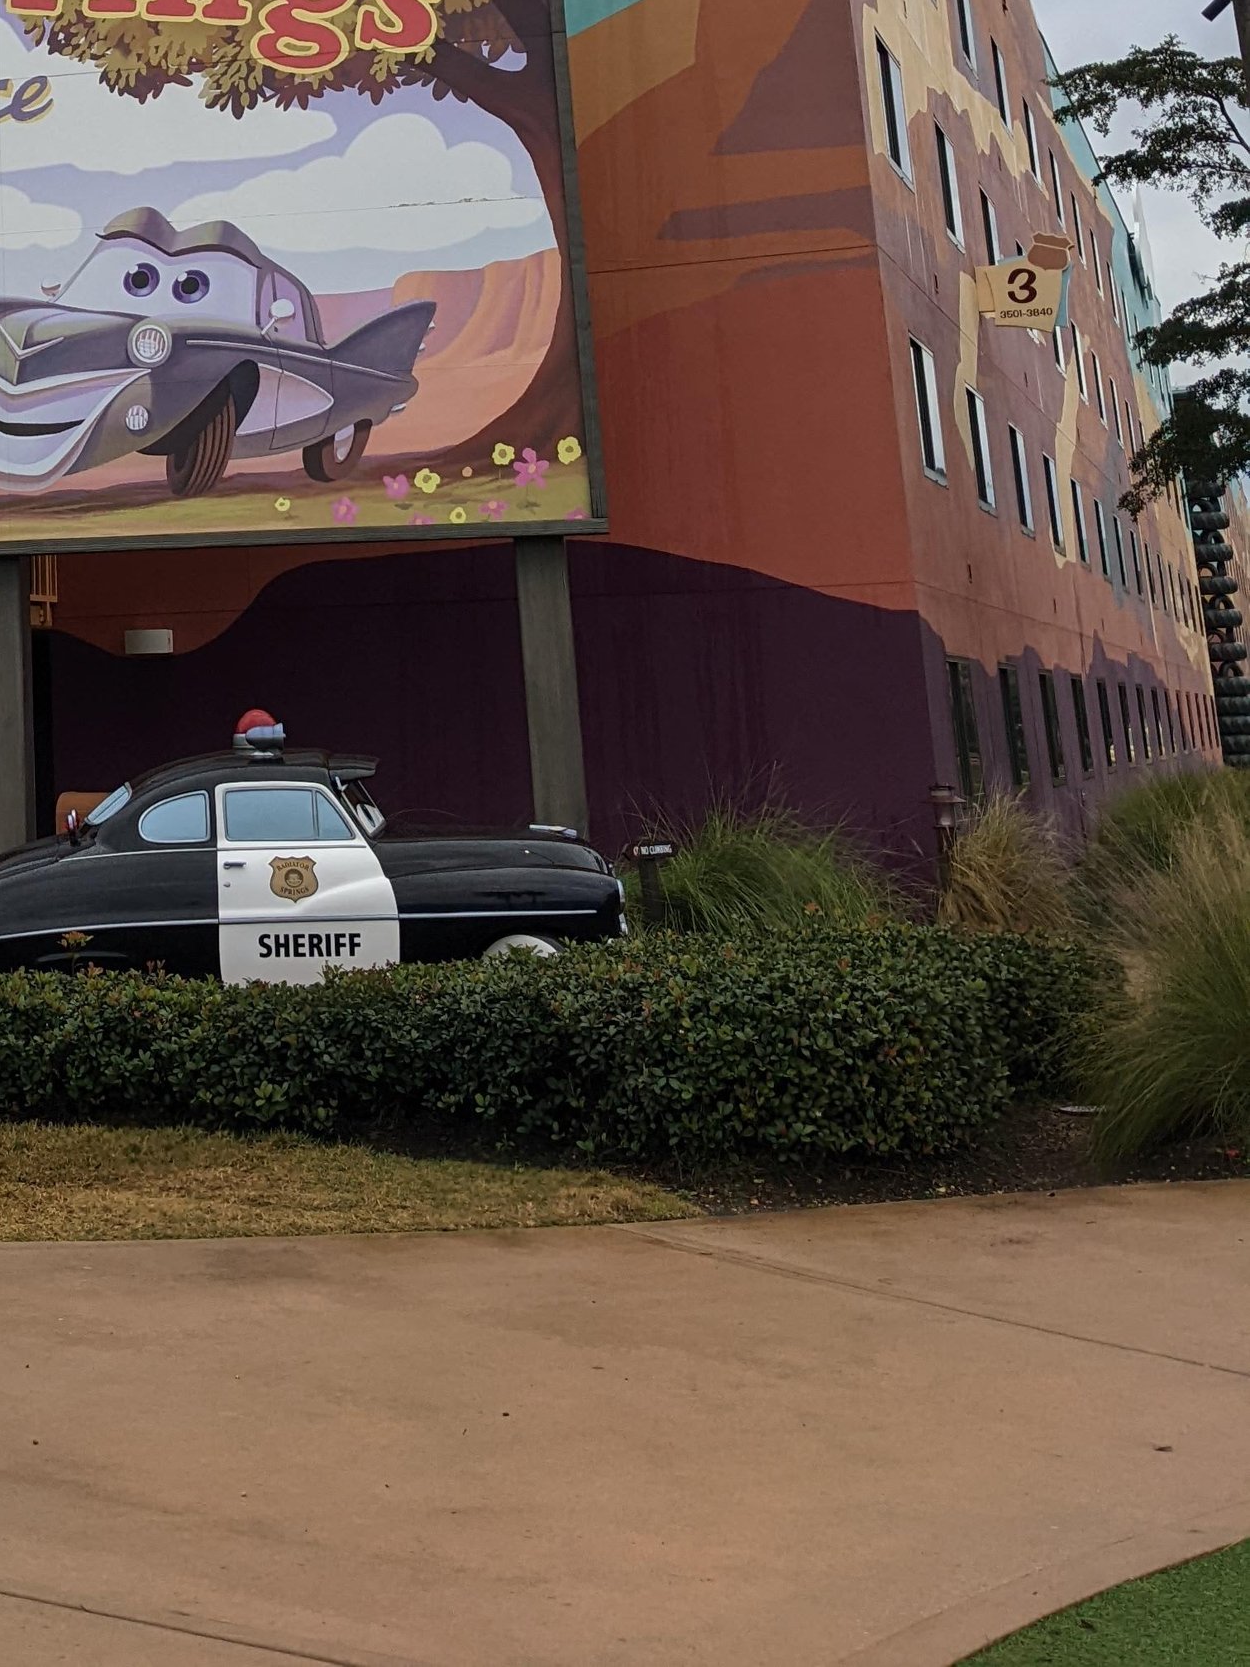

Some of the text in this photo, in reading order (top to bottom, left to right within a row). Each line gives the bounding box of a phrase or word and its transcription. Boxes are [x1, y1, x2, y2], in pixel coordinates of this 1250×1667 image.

[1007, 268, 1037, 304] 3
[1000, 307, 1053, 318] 3501-3840
[276, 861, 310, 872] RADIATOR
[258, 933, 361, 958] SHERIFF
